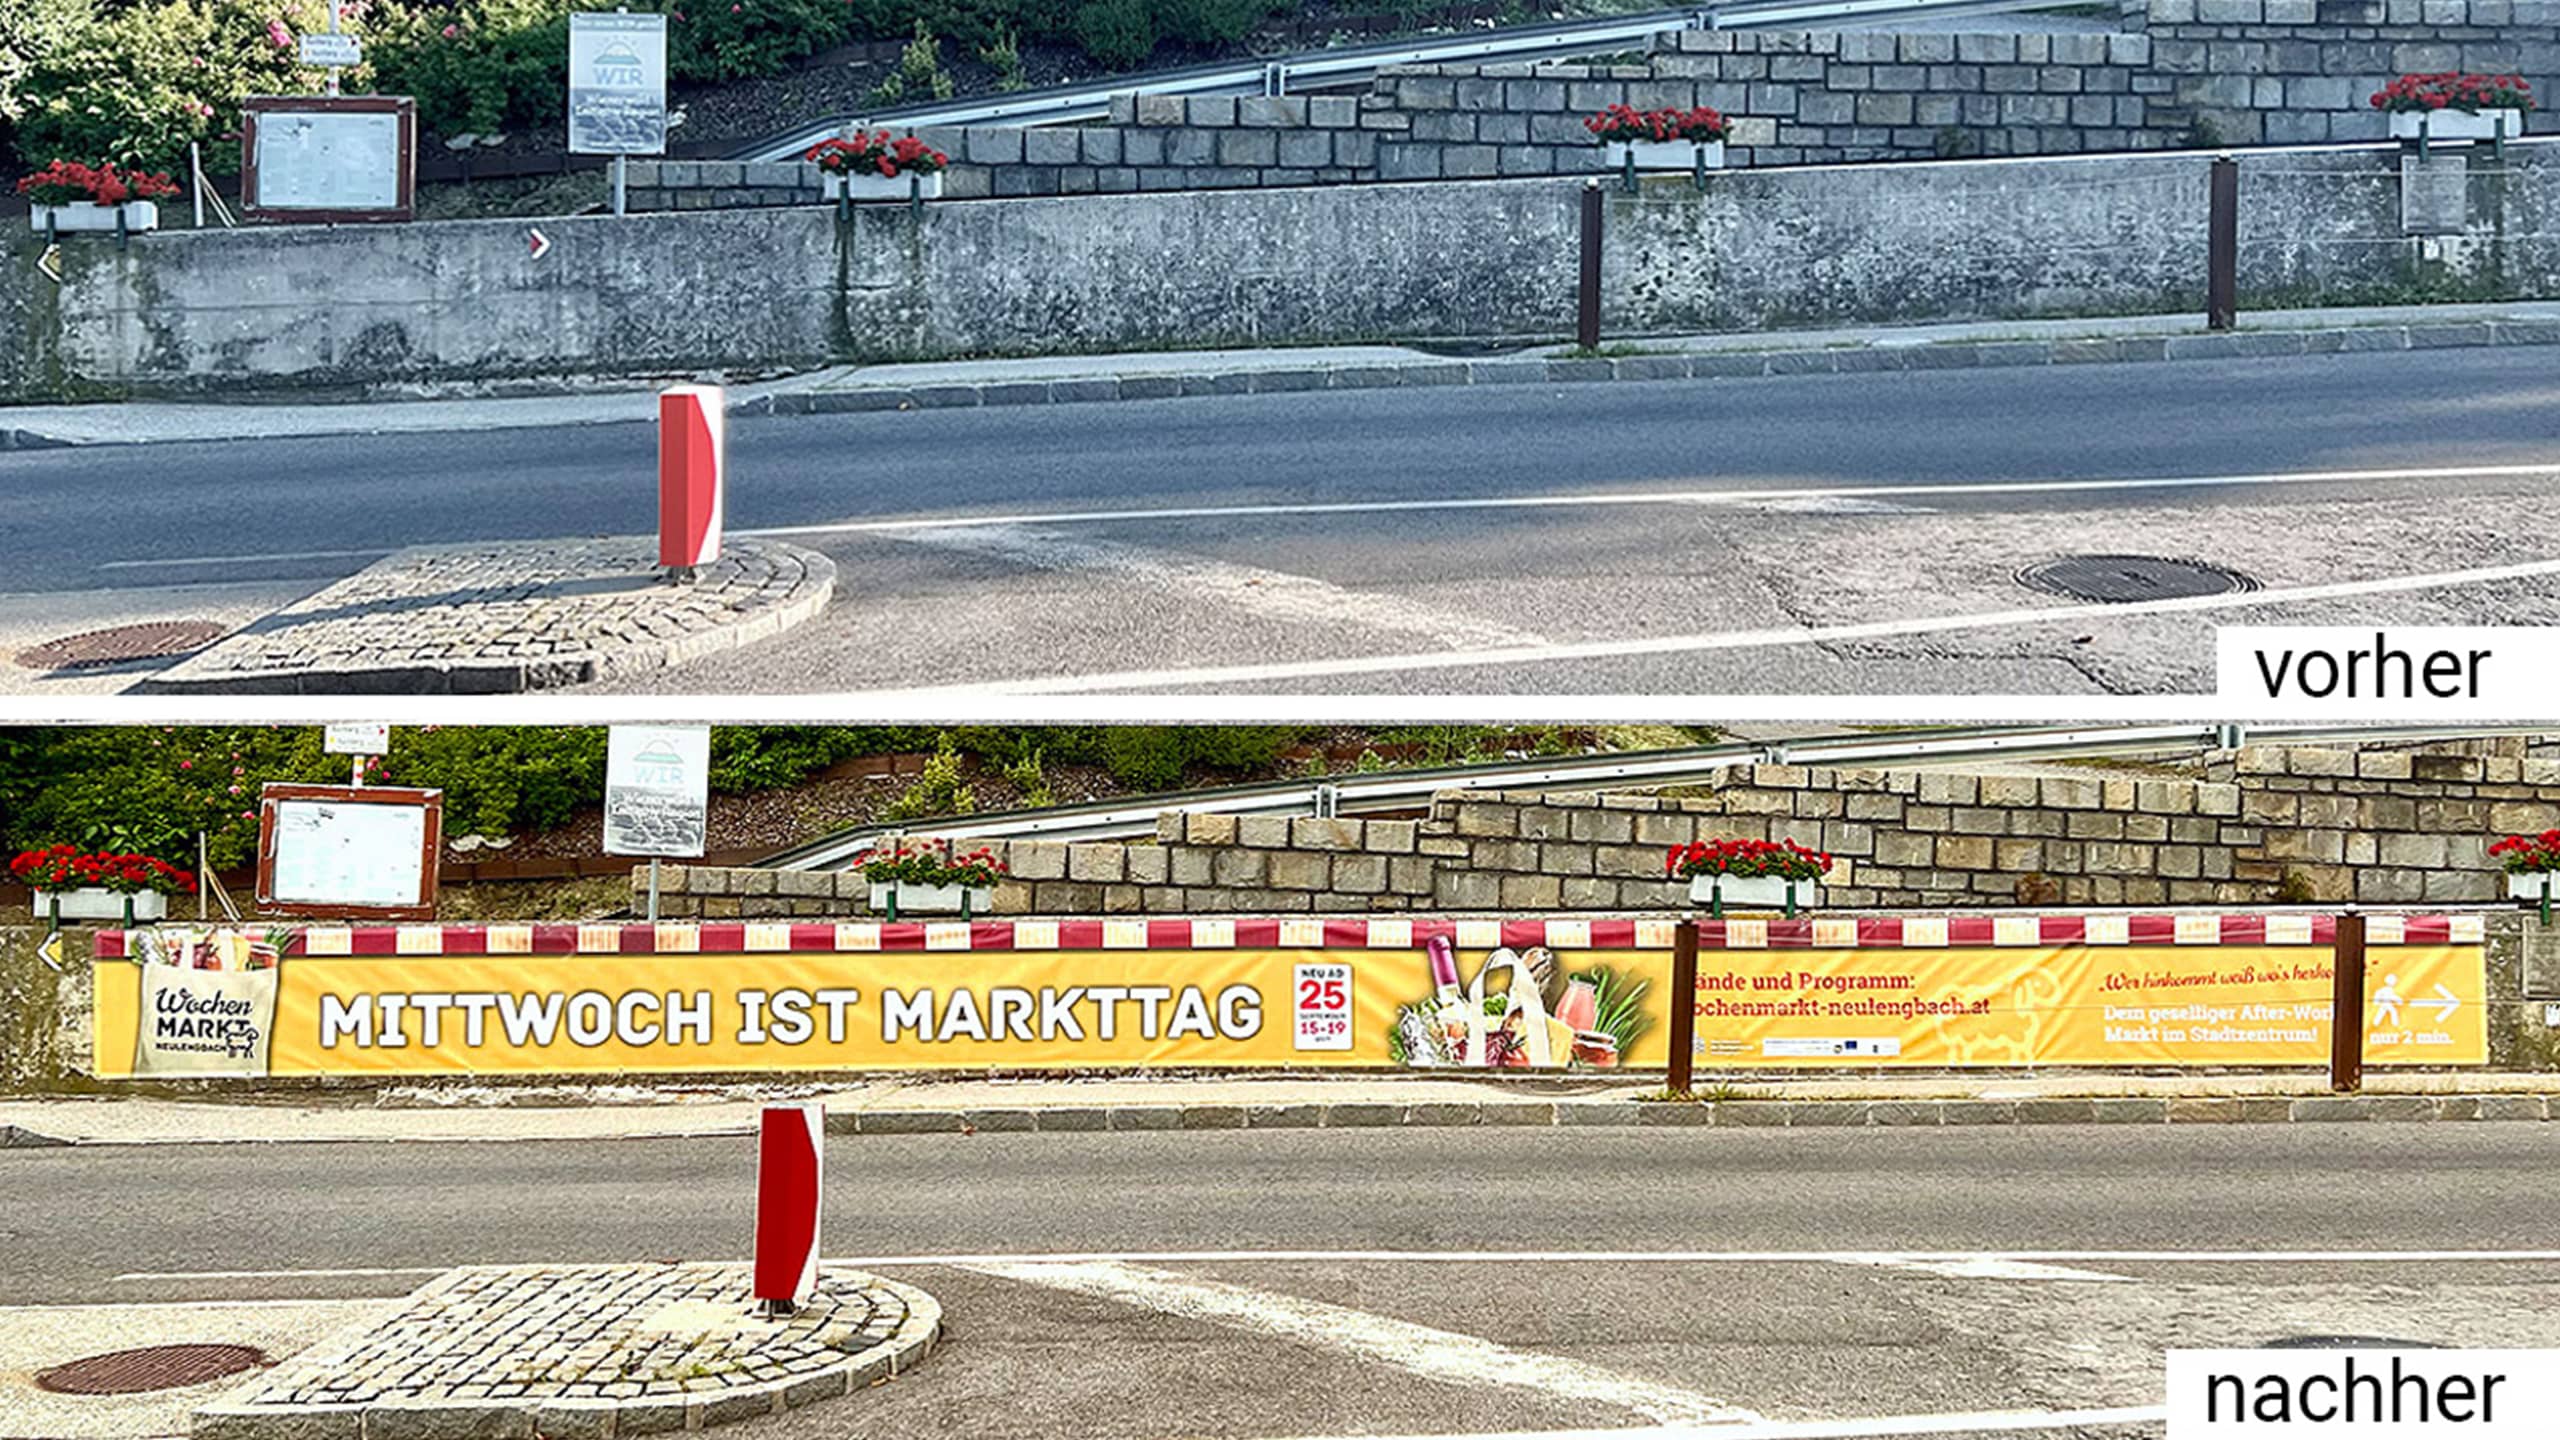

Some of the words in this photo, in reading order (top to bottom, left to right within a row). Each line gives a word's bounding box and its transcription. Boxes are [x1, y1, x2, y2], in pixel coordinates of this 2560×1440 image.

[593, 66, 643, 85] WIR
[633, 766, 684, 784] WIR
[1301, 968, 1326, 978] NEU
[1752, 971, 1793, 991] und
[1799, 971, 1915, 994] Programm:
[155, 987, 253, 1016] Wochen
[1299, 979, 1347, 1010] 25
[319, 989, 713, 1049] MITTWOCH
[735, 987, 859, 1045] IST
[881, 983, 1264, 1043] MARKTTAG
[1693, 997, 1991, 1019] ochenmarkt-neulengbach.at
[2149, 1003, 2235, 1024] geselliger
[157, 1016, 251, 1039] MARKT
[2104, 1026, 2159, 1042] Markt
[2162, 1026, 2186, 1042] im
[2189, 1025, 2318, 1043] Stadtzentrum!
[2402, 1030, 2413, 1044] 2
